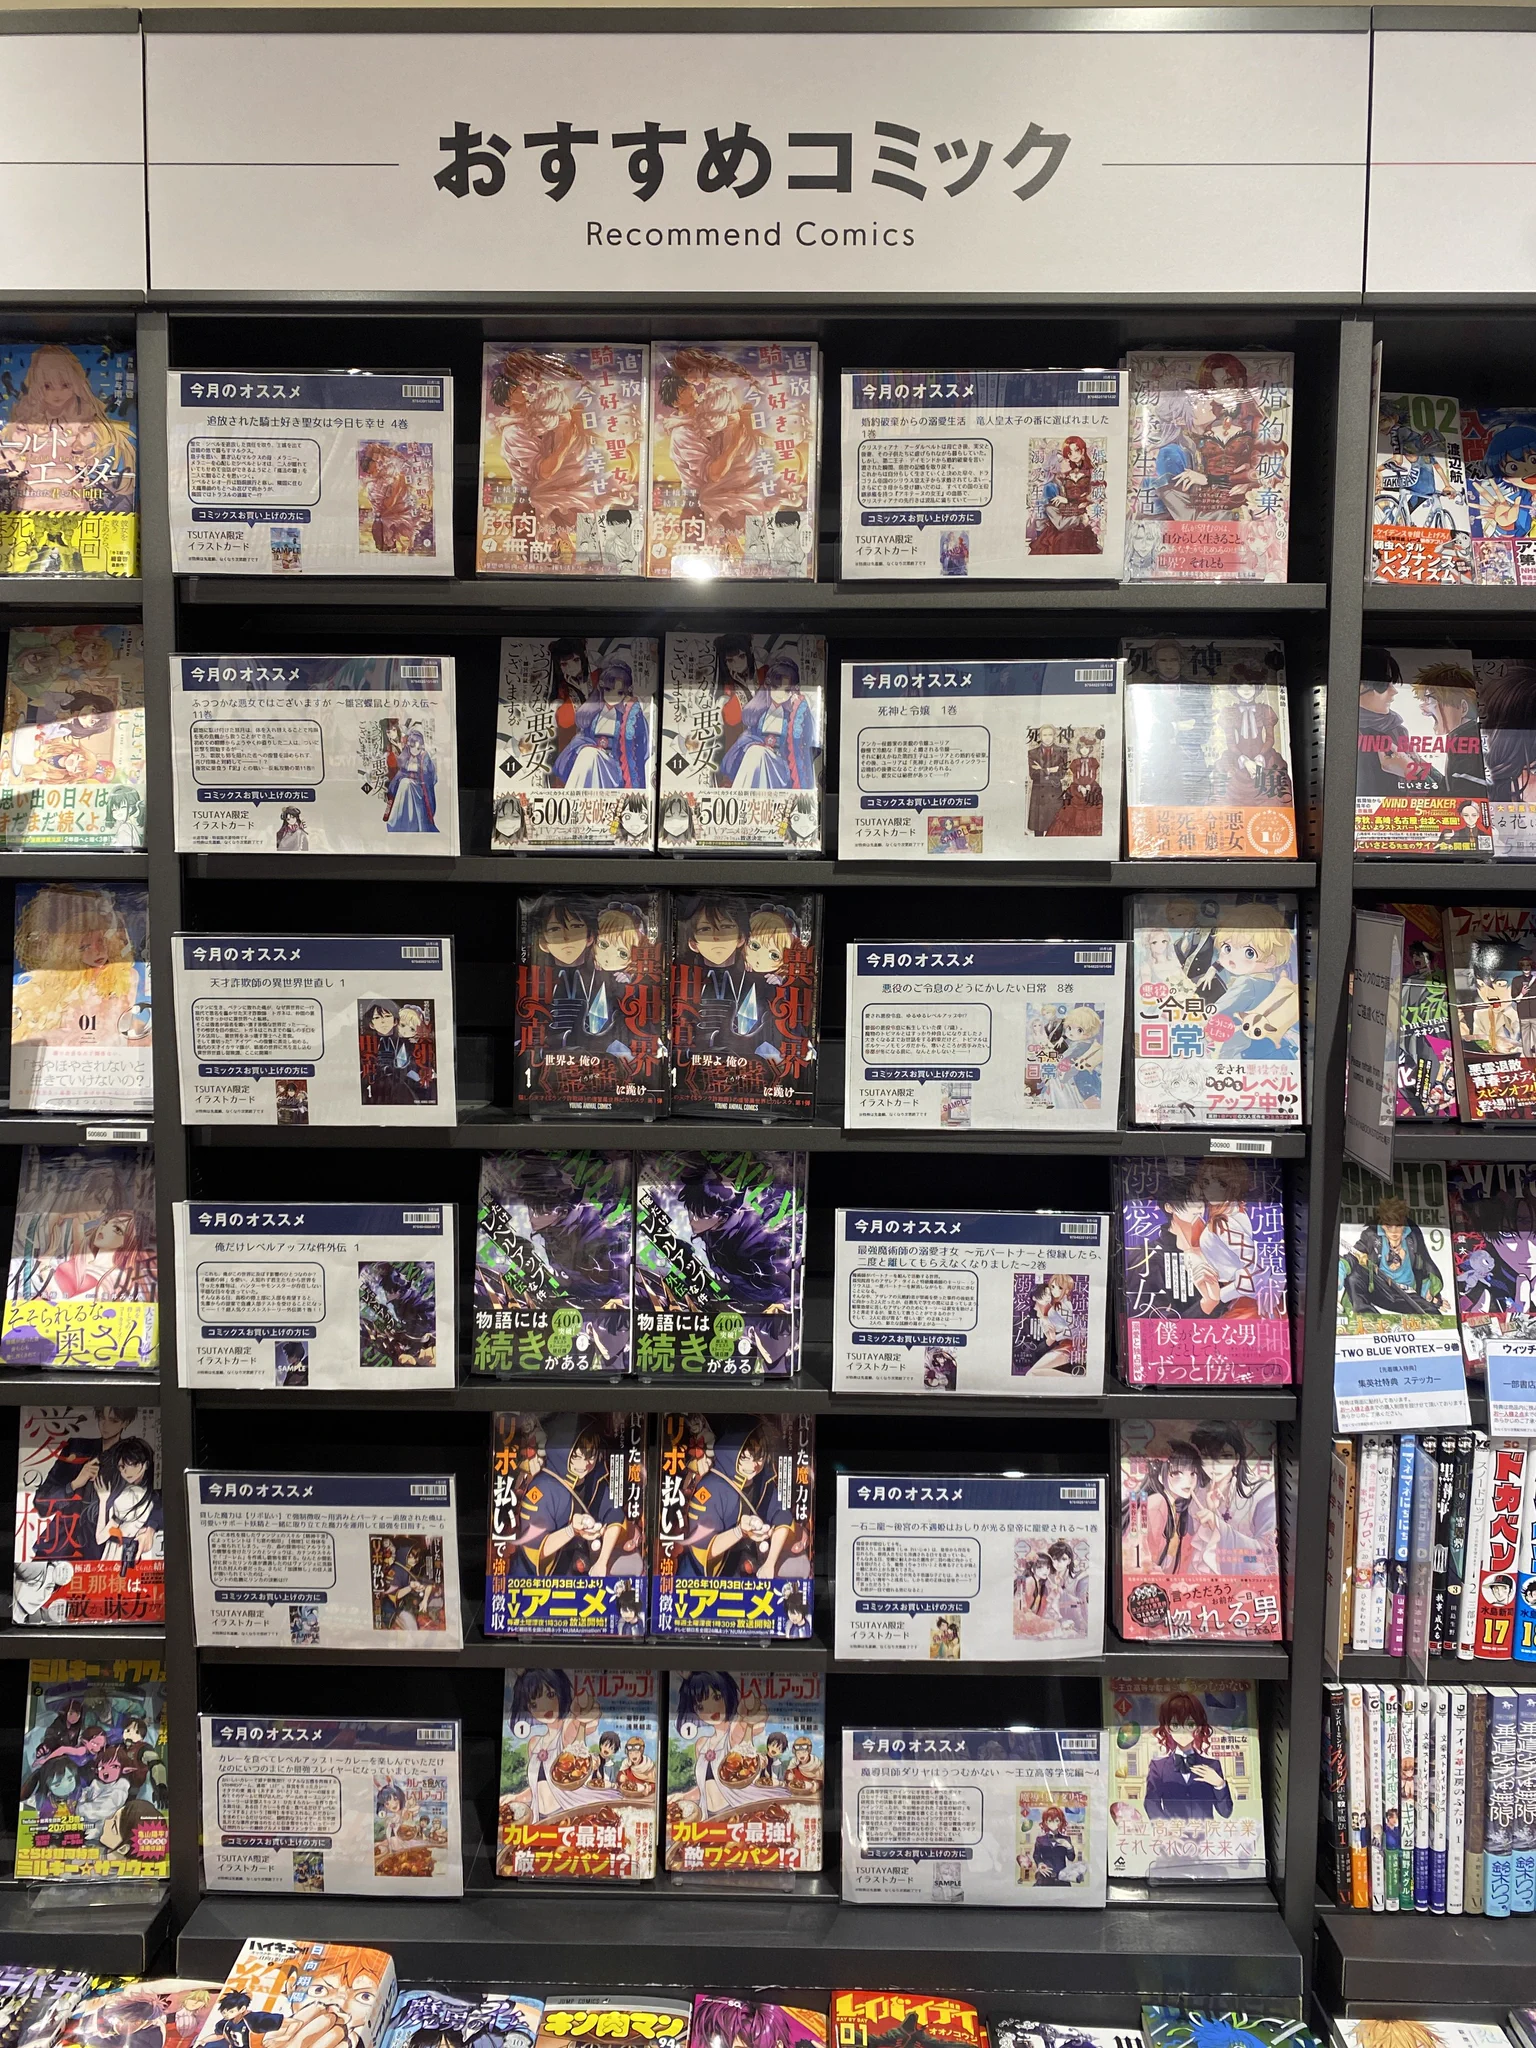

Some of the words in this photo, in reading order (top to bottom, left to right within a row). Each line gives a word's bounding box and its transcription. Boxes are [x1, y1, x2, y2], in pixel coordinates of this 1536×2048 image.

[432, 119, 1073, 202] おすすめコミック
[586, 220, 782, 250] Recommend
[796, 220, 916, 250] Comics
[190, 383, 301, 399] 今月のオススメ
[862, 383, 974, 399] 今月のオススメ
[207, 416, 384, 429] 追放された騎士好き聖女は今日も幸せ
[391, 418, 408, 429] 4巻
[861, 416, 966, 427] 婚約破棄からの溺愛生活
[976, 415, 1108, 425] 竜人皇太子の番に選ばれました
[576, 386, 609, 496] 今日も幸せ
[745, 385, 777, 497] 今日も幸せ
[862, 429, 876, 439] 1巻
[1447, 442, 1465, 484] 渡辺航
[24, 457, 135, 487] エンダー
[199, 511, 304, 521] コミックスお買い上げの方に
[868, 513, 974, 523] コミックスお買い上げの方に
[78, 519, 101, 560] 何回
[186, 531, 244, 540] TSUTAYA限定
[854, 535, 913, 544] TSUTAYA限定
[854, 546, 918, 555] イラストカード
[1374, 540, 1424, 551] 弱虫ペダル
[1383, 551, 1455, 568] レゾナンス
[1381, 566, 1455, 583] ペダイズム
[191, 667, 300, 682] 今月のオススメ
[669, 638, 688, 724] ございますが
[862, 673, 972, 689] 今月のオススメ
[504, 642, 522, 727] ございますが
[193, 699, 331, 709] ふつつかな悪女ではございますが
[878, 706, 930, 716] 死神と令嬢
[942, 706, 957, 715] 1巻
[1397, 736, 1480, 754] BREAKER
[505, 761, 516, 771] 11
[672, 759, 682, 769] 11
[1406, 762, 1432, 780] 27
[1398, 782, 1439, 790] にいさとる
[204, 791, 308, 799] コミックスお買い上げの方に
[867, 798, 971, 806] コミックスお買い上げの方に
[1382, 799, 1408, 808] WIND
[854, 818, 911, 827] TSUTAYA限定
[854, 828, 916, 837] イラストカード
[1225, 811, 1244, 851] 悪女
[193, 947, 301, 962] 今月のオススメ
[867, 953, 974, 967] 今月のオススメ
[210, 978, 333, 988] 天才詐欺師の異世界世直し
[882, 984, 1047, 993] 悪役のご令息のどうにかしたい日常
[1057, 984, 1074, 993] 8巻
[1140, 996, 1217, 1022] ご令息の
[79, 1014, 97, 1031] 01
[1415, 1025, 1446, 1037] ネオショコ
[1140, 1023, 1205, 1057] 日常
[545, 1055, 576, 1066] 世界よ
[580, 1055, 600, 1066] 俺の
[691, 1055, 722, 1066] 世界よ
[726, 1055, 747, 1067] 俺の
[205, 1067, 308, 1075] コミックスお買い上げの方に
[872, 1070, 973, 1078] コミックスお買い上げの方に
[1468, 1060, 1523, 1076] 悪霊退散
[193, 1085, 250, 1094] TSUTAYA限定
[859, 1088, 914, 1097] TSUTAYA限定
[859, 1098, 919, 1107] イラストカード
[1206, 1094, 1298, 1113] アップ中!?
[199, 1212, 305, 1227] 今月のオススメ
[855, 1219, 962, 1235] 今月のオススメ
[1429, 1229, 1444, 1251] 9
[215, 1243, 346, 1252] 俺だけレベルアップな件外伝
[858, 1246, 959, 1257] 最強魔術師の溺愛才女
[476, 1311, 548, 1329] 物語には
[637, 1313, 710, 1332] 物語には
[208, 1328, 309, 1336] コミックスお買い上げの方に
[1373, 1334, 1415, 1343] BORUTO
[55, 1320, 159, 1364] 奥さん
[859, 1335, 960, 1344] コミックスお買い上げの方に
[196, 1347, 252, 1355] TSUTAYA限定
[475, 1332, 546, 1371] 続き
[636, 1334, 708, 1372] 続き
[846, 1353, 901, 1361] TSUTAYA限定
[1367, 1347, 1392, 1356] BLUE
[196, 1356, 257, 1365] イラストカード
[545, 1354, 590, 1371] がある
[707, 1358, 752, 1374] がある
[846, 1363, 906, 1371] イラストカード
[1358, 1378, 1398, 1388] 集英社特典
[1404, 1377, 1441, 1385] ステッカー
[627, 1414, 642, 1518] 貸した魔力は
[796, 1414, 811, 1521] 貸した魔力は
[209, 1483, 314, 1498] 今月のオススメ
[858, 1487, 962, 1501] 今月のオススメ
[1475, 1462, 1488, 1522] スノードロップ
[1490, 1451, 1525, 1572] ドカベン
[1376, 1547, 1386, 1557] 11
[67, 1574, 148, 1594] 旦那様は、
[508, 1578, 603, 1589] 2026年10月3日(土)より
[675, 1579, 771, 1590] 2026年10月3日(土)より
[1470, 1583, 1476, 1594] 2
[221, 1592, 320, 1601] コミックスお買い上げの方に
[862, 1603, 963, 1611] コミックスお買い上げの方に
[1481, 1606, 1513, 1616] 水島新司
[1483, 1618, 1510, 1644] 17
[574, 1674, 653, 1697] レベルアップ!
[740, 1673, 821, 1699] レベルアップ!
[1119, 1701, 1126, 1712] 4
[220, 1727, 322, 1741] 今月のオススメ
[1220, 1736, 1247, 1744] 赤羽にな
[862, 1739, 965, 1753] 今月のオススメ
[861, 1768, 999, 1778] 魔導具師ダリヤはうつむかない
[1401, 1803, 1413, 1837] ギャル
[672, 1822, 792, 1843] カレーで最強!
[1117, 1820, 1256, 1837] 王立高等学院卒業
[228, 1838, 326, 1846] コミックスお買い上げの方に
[504, 1826, 623, 1850] カレーで最強!
[1404, 1839, 1413, 1847] 22
[867, 1850, 965, 1858] コミックスお買い上げの方に
[1115, 1839, 1257, 1857] それぞれの未来へ!
[514, 1852, 632, 1876] 敵ワンパン!?
[684, 1847, 800, 1869] 敵ワンパン!?
[855, 1867, 908, 1875] TSUTAYA限定
[855, 1876, 914, 1884] イラストカード
[250, 1940, 309, 1955] ハイキュー!!
[545, 2011, 684, 2039] キン肉マン
[840, 2022, 868, 2046] 01
